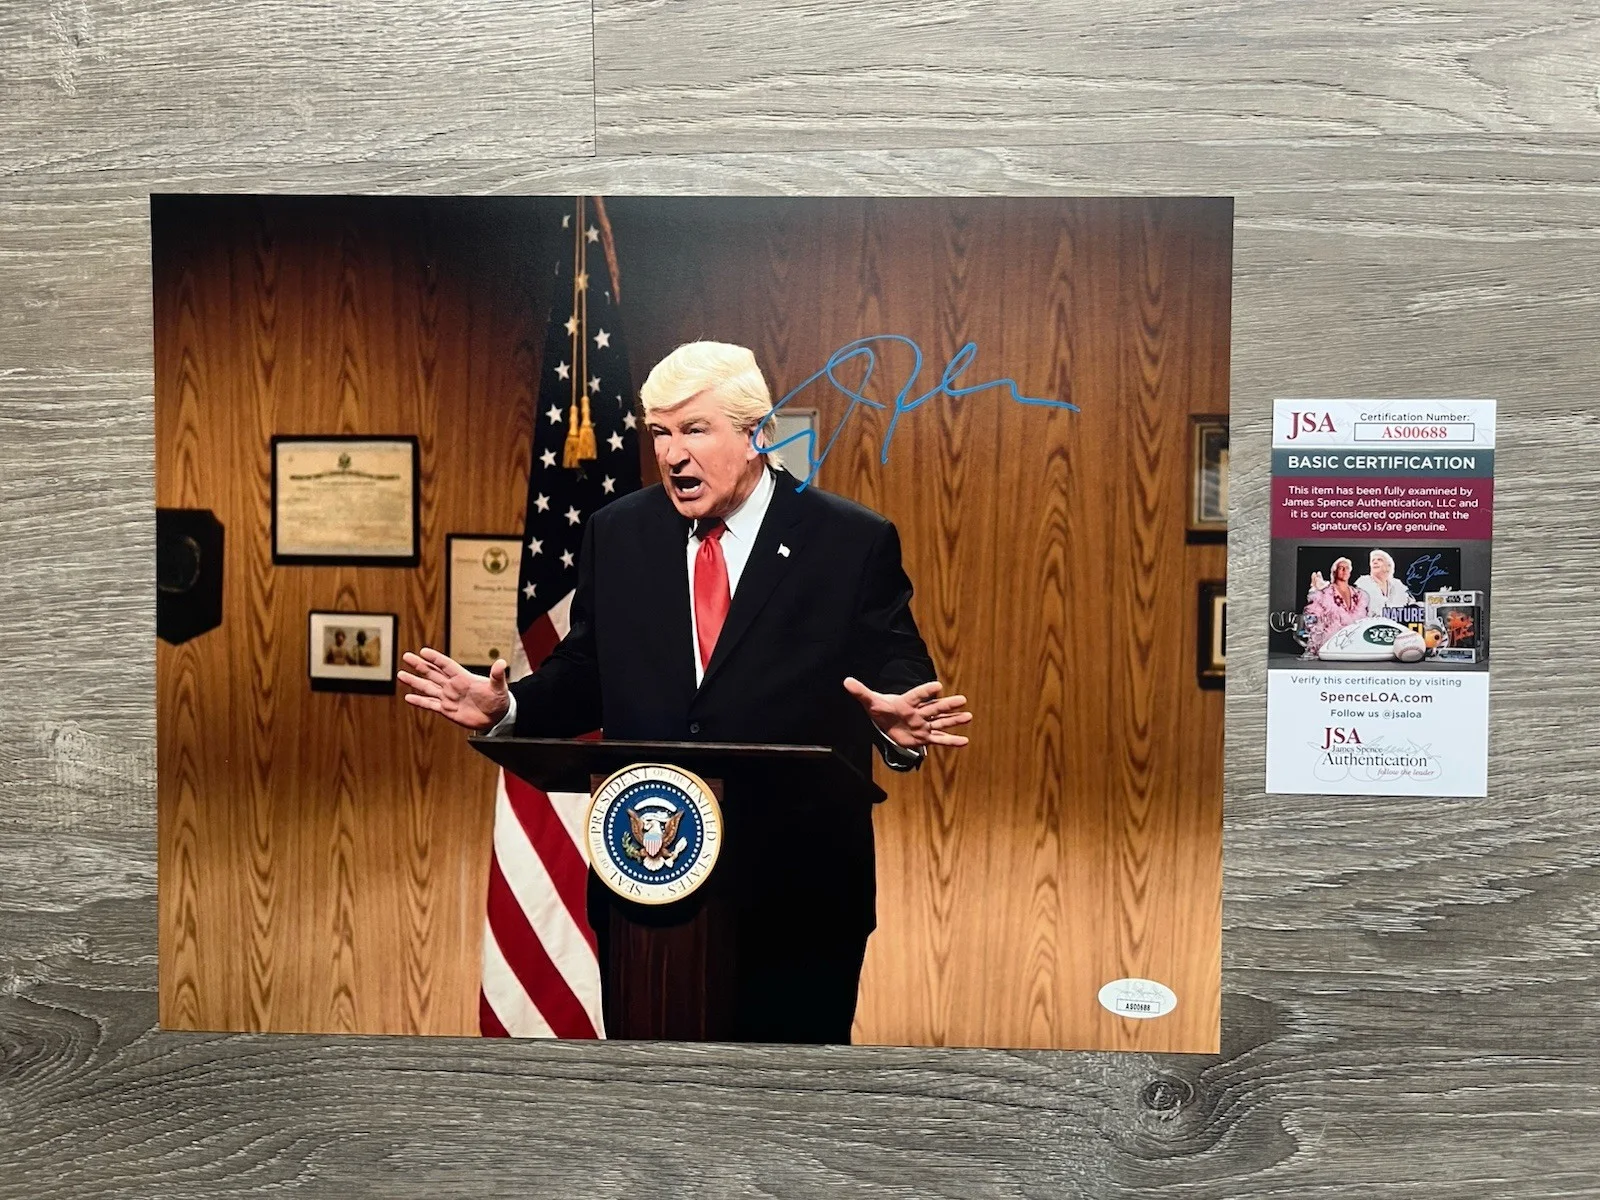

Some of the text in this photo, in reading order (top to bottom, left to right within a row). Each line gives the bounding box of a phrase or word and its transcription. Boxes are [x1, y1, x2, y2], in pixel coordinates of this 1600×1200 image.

[1360, 412, 1470, 422] Certification Number:
[1286, 412, 1337, 440] JSA
[1381, 426, 1448, 439] AS00688
[1288, 455, 1476, 470] BASIC CERTIFICATION
[1288, 486, 1473, 497] This item has been fully examined by
[1282, 498, 1479, 508] James Spence Authentication, LLC and
[1290, 509, 1470, 521] it is our considered opinion that the
[1311, 521, 1448, 533] signature(s) is/are genuine.
[1382, 607, 1425, 622] NATURE
[1291, 675, 1462, 688] Verify this certification by visiting
[1320, 691, 1433, 704] SpenceLOA.com
[1330, 709, 1365, 718] Follow
[1383, 709, 1422, 719] @jsaloa
[1321, 727, 1362, 750] JSA
[1332, 745, 1382, 754] James Spence
[1322, 752, 1427, 767] Authentication
[1377, 768, 1435, 776] follow the leader
[591, 768, 648, 834] PRESIDENT
[686, 779, 717, 842] UNITED
[667, 851, 712, 896] STATES
[610, 871, 643, 896] SEAL
